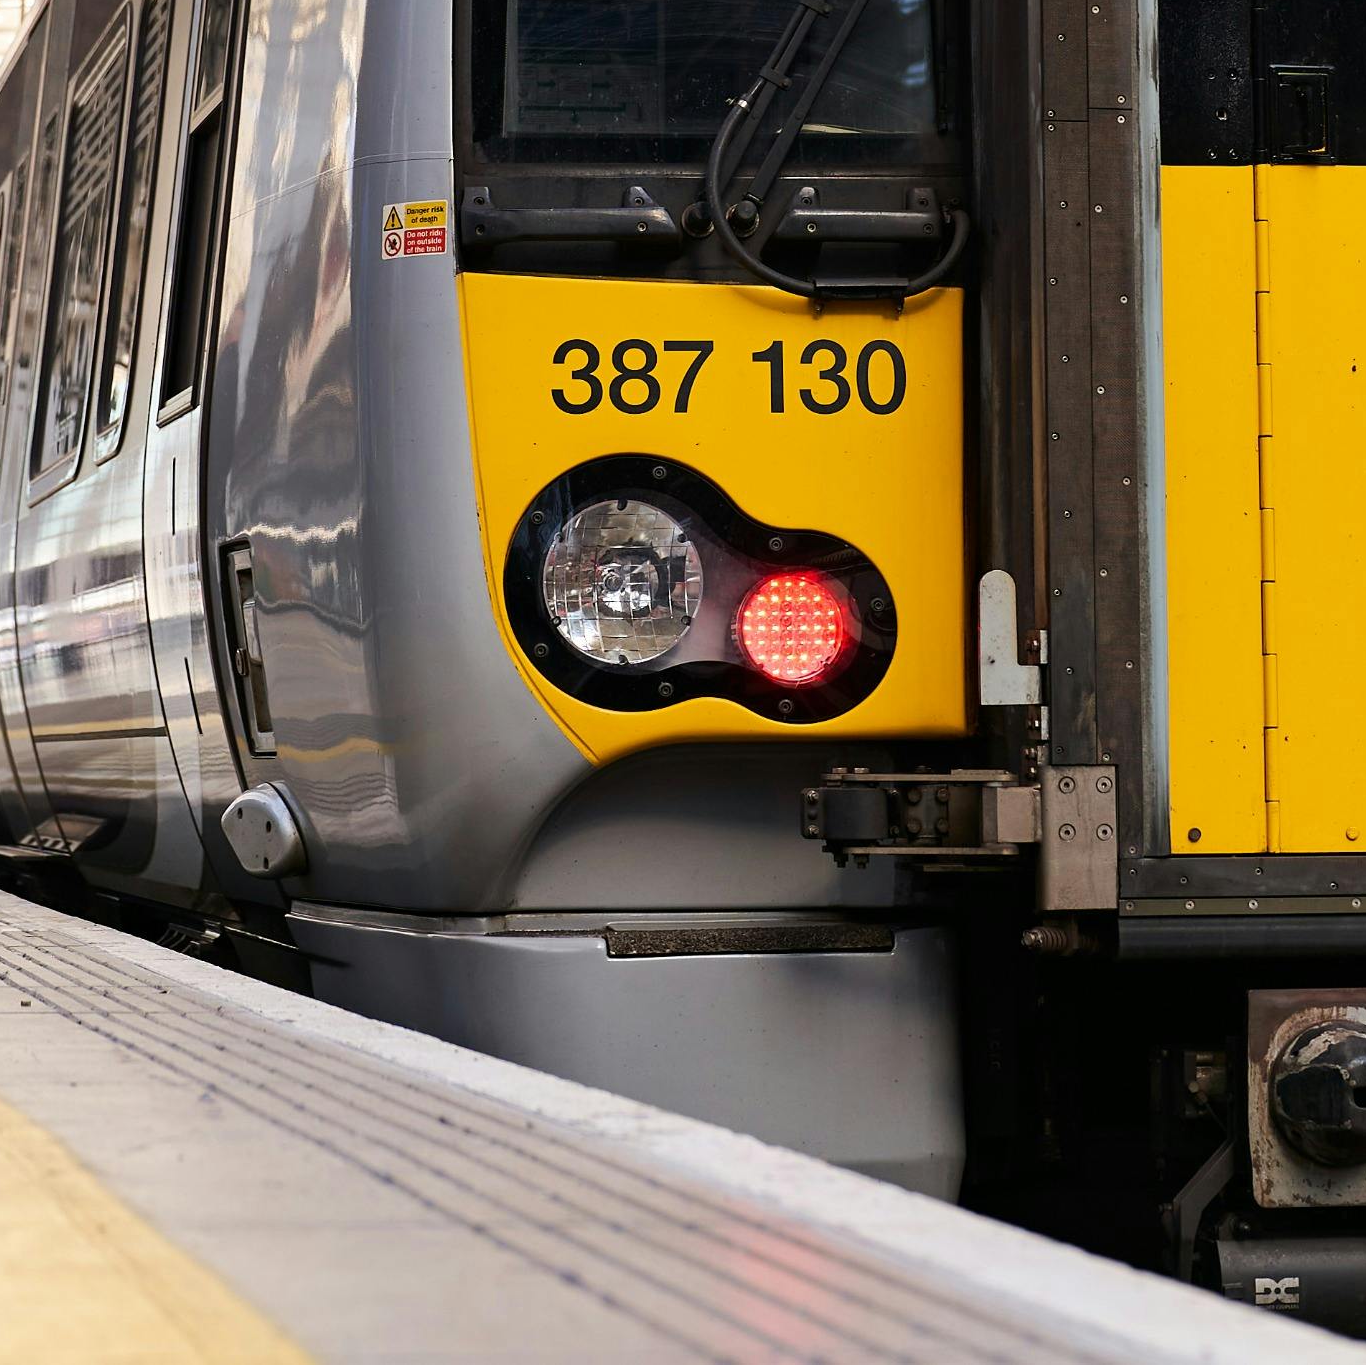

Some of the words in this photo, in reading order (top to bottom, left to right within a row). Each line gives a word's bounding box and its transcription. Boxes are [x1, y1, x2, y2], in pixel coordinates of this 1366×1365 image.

[407, 207, 429, 215] Danger
[419, 215, 438, 223] death
[551, 339, 714, 415] 387
[752, 339, 907, 415] 130
